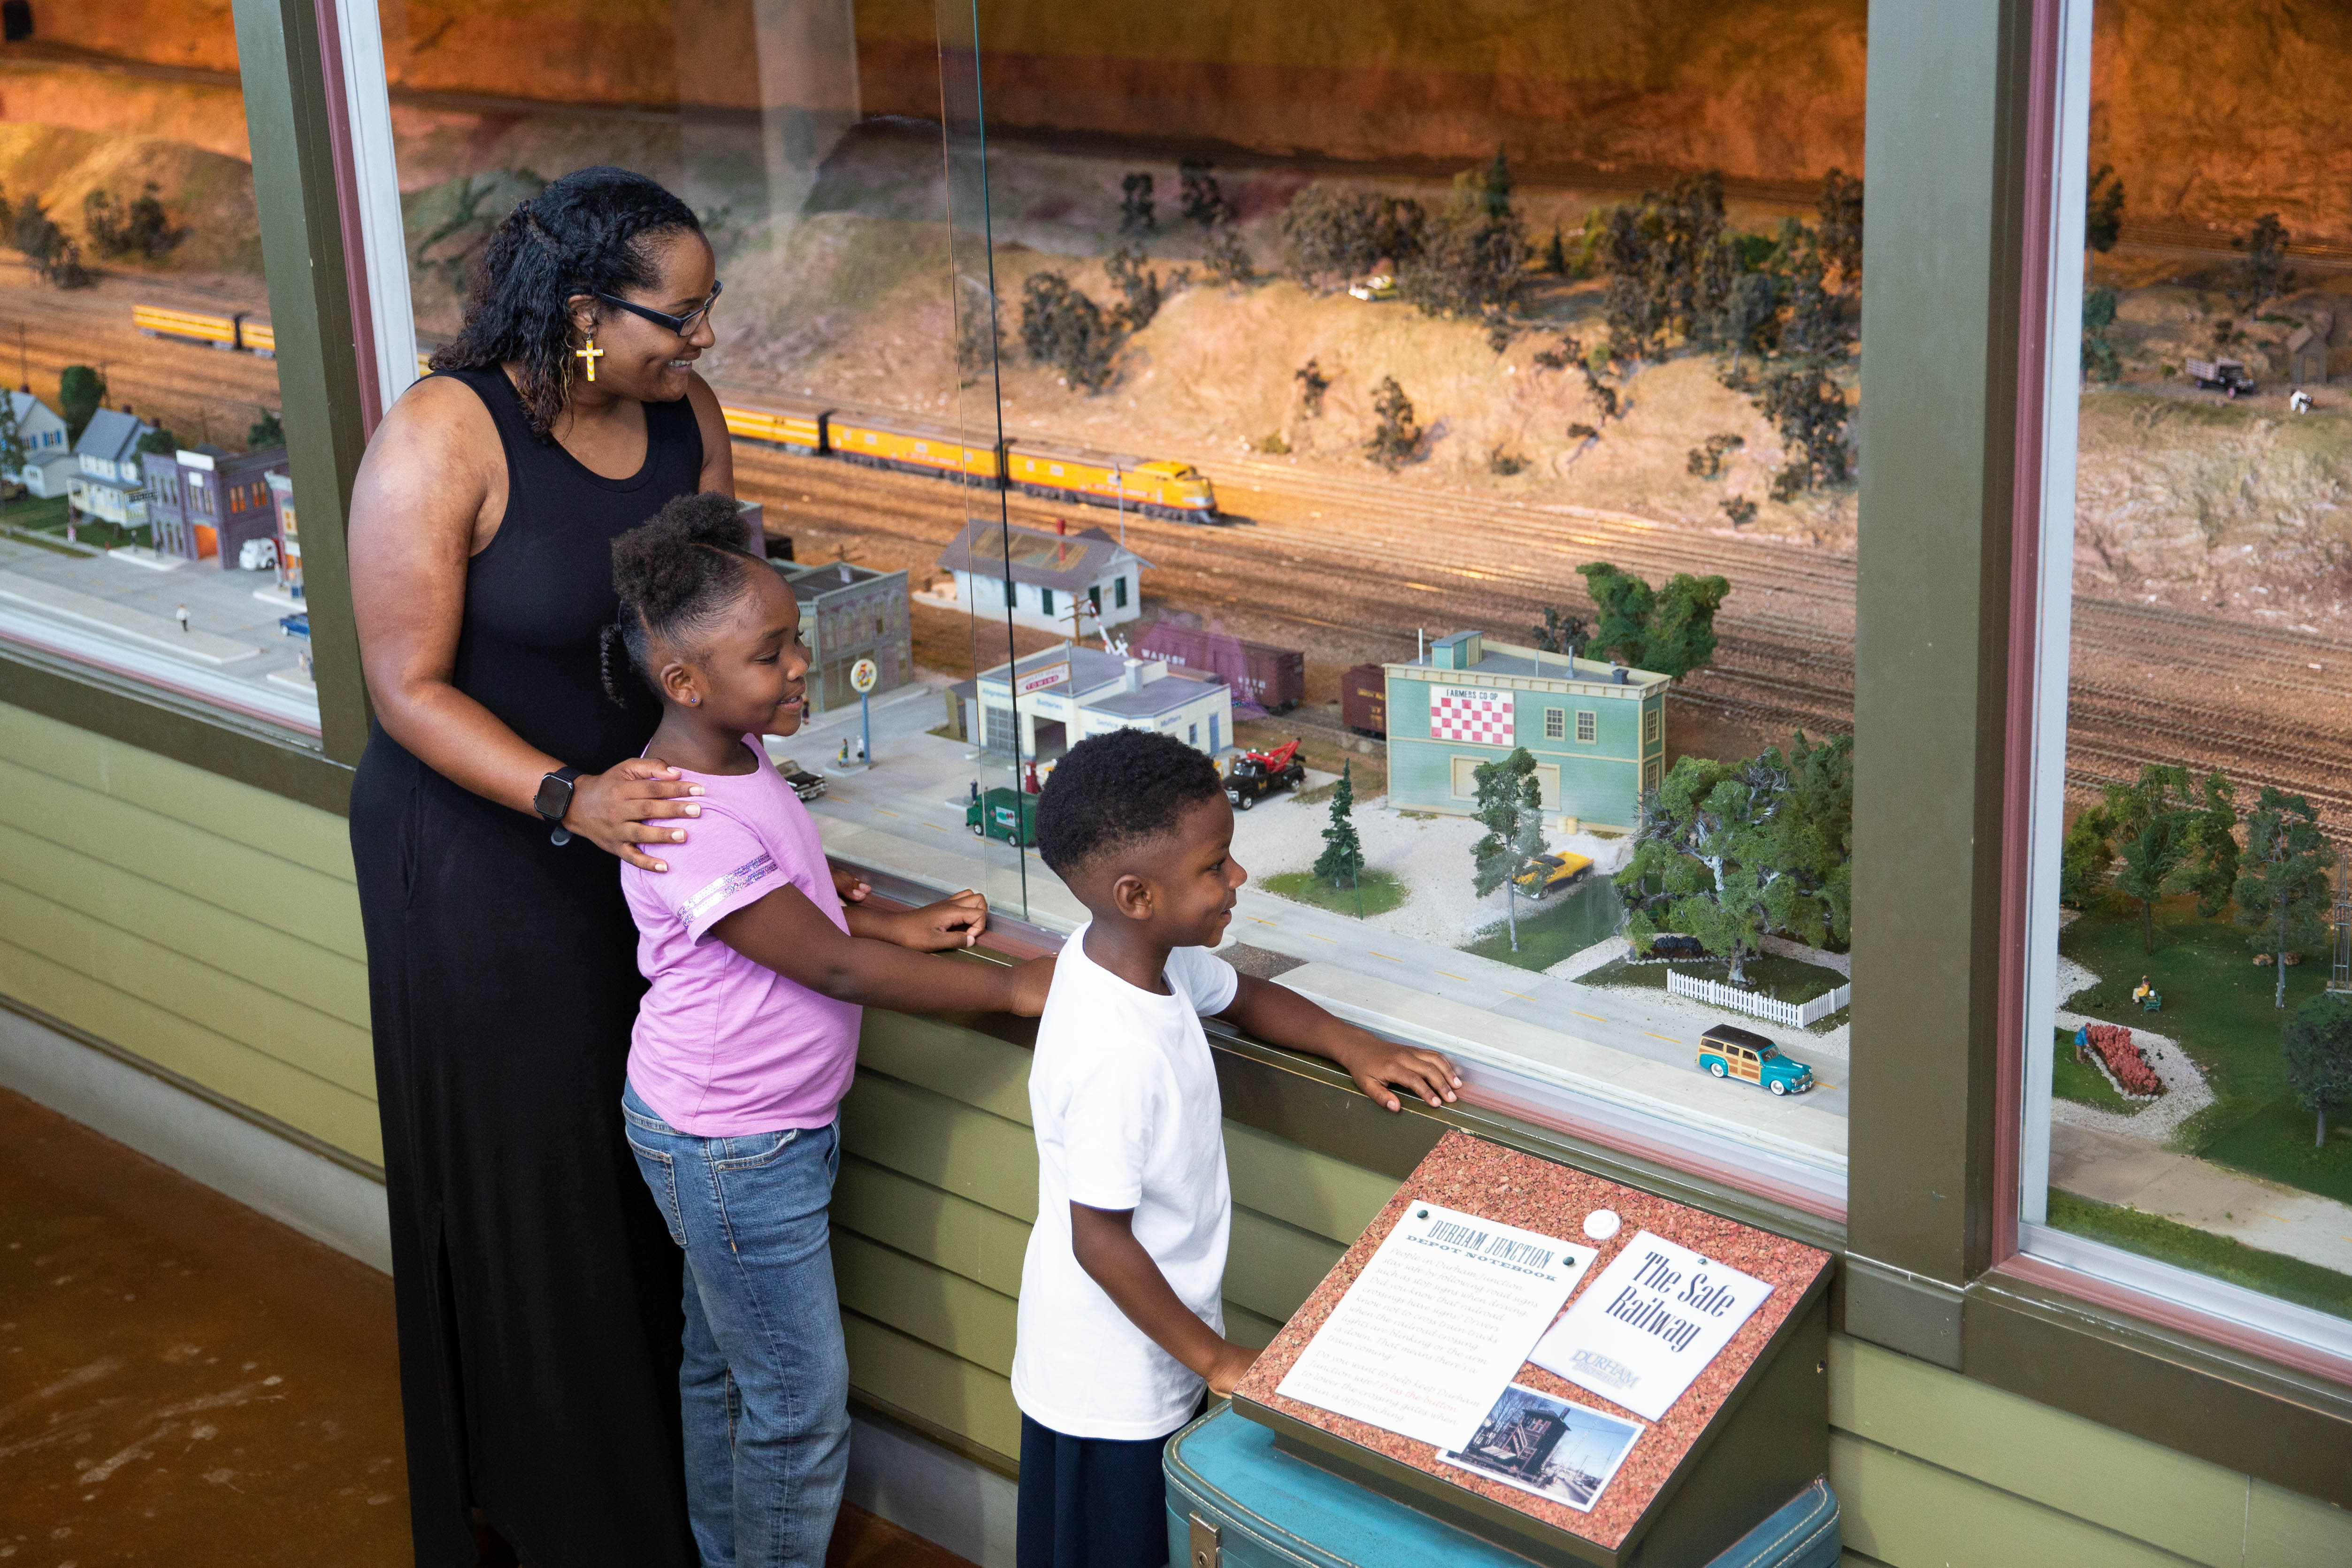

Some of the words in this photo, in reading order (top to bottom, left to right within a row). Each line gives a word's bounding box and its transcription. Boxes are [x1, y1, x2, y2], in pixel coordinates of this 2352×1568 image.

[1141, 649, 1185, 665] WABASH
[1027, 675, 1058, 690] TOWING
[1447, 689, 1476, 699] FARMERS
[1406, 1235, 1462, 1254] DEPOT
[1464, 1251, 1557, 1281] NOTEBOOK
[1428, 1220, 1488, 1250] DURHAM
[1485, 1237, 1554, 1269] JUNCTION
[1424, 1269, 1437, 1278] by
[1632, 1251, 1681, 1293] The
[1677, 1273, 1735, 1317] Safe
[1604, 1285, 1702, 1353] Railway
[1315, 1350, 1330, 1358] Do
[1572, 1350, 1639, 1388] DURHAM
